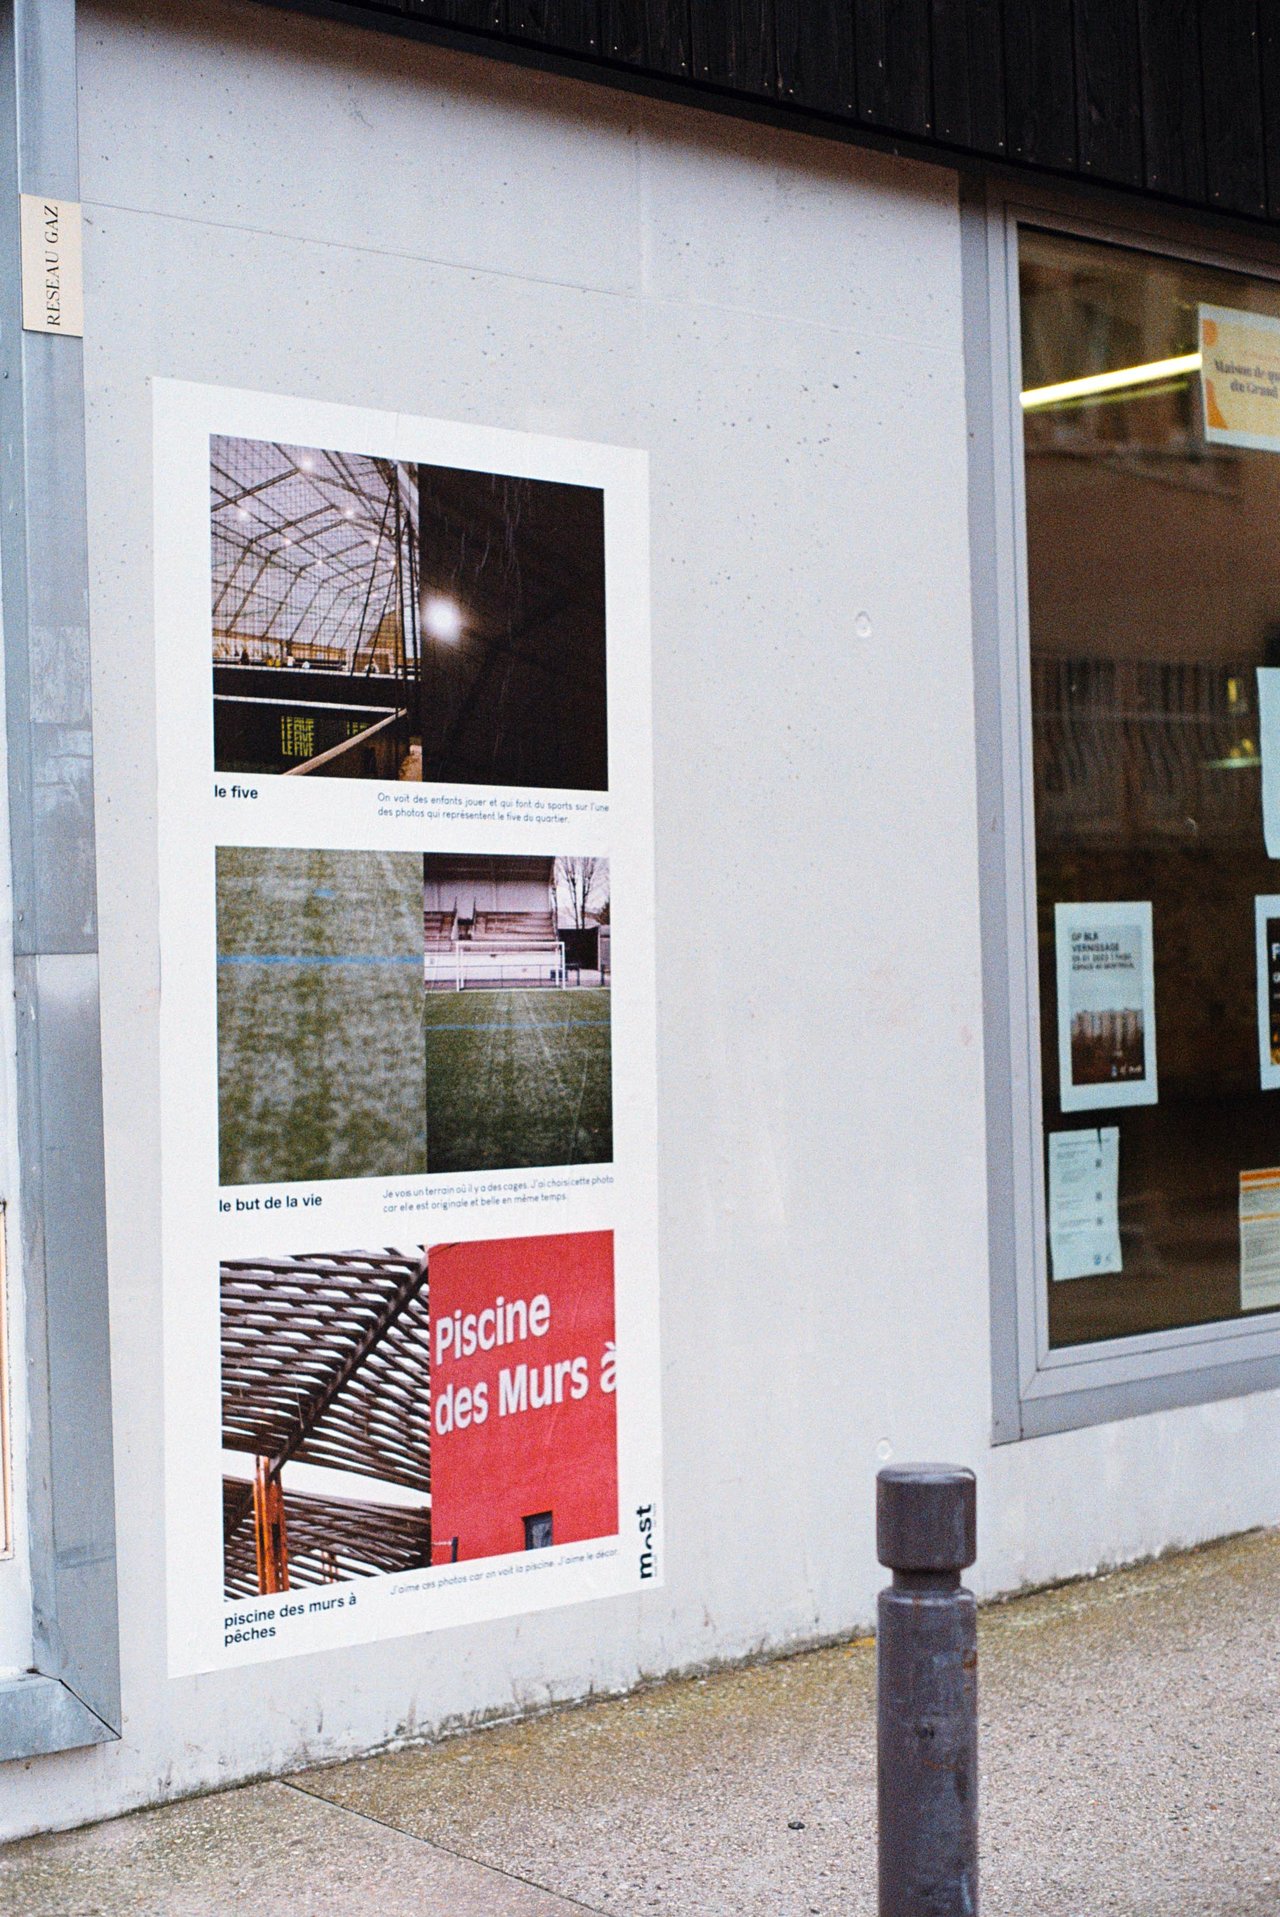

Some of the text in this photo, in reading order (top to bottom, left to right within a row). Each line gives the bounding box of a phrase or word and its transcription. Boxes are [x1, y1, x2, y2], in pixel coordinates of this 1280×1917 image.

[44, 204, 61, 326] RESEAU GAZ
[214, 784, 258, 799] le five
[377, 792, 391, 802] On
[393, 793, 410, 803] voit
[413, 795, 428, 804] des
[431, 795, 463, 806] enfants
[465, 798, 486, 808] jouer
[489, 798, 498, 807] et
[500, 798, 513, 809] qui
[515, 798, 532, 808] font
[534, 800, 545, 809] du
[547, 801, 573, 812] sports
[378, 807, 393, 816] des
[395, 807, 425, 819] photos
[427, 809, 441, 820] qui
[506, 812, 521, 821] five
[523, 814, 533, 823] du
[383, 1189, 393, 1199] Je
[425, 1186, 455, 1196] terrain
[487, 1182, 502, 1192] des
[591, 1174, 614, 1186] photo
[218, 1193, 323, 1213] le but de la vie
[383, 1205, 397, 1213] car
[416, 1200, 429, 1210] est
[502, 1196, 512, 1205] en
[436, 1294, 551, 1366] Piscine
[435, 1341, 617, 1436] des Murs à
[224, 1592, 357, 1629] piscine des murs à
[224, 1626, 276, 1647] pêches
